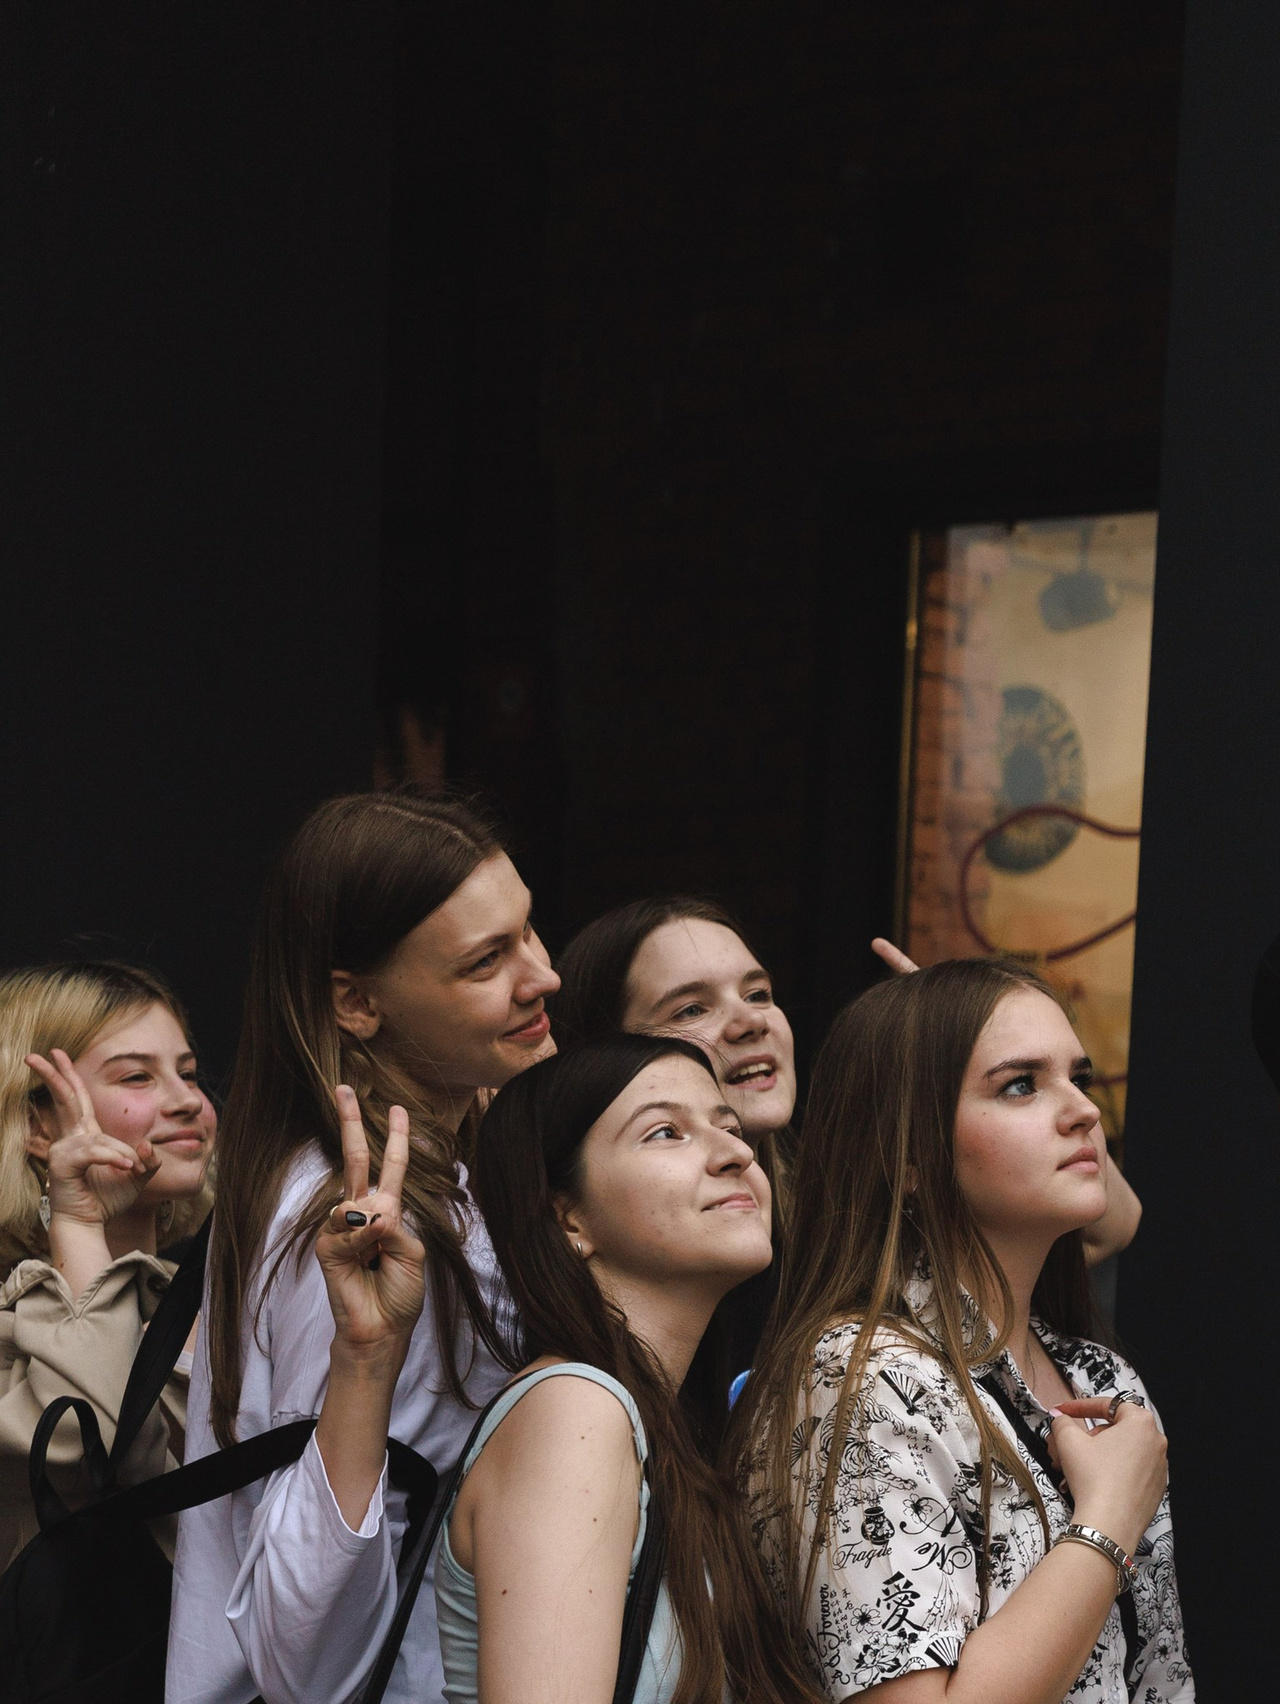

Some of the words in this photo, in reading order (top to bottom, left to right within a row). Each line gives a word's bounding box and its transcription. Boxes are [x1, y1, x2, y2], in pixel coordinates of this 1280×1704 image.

[832, 1540, 893, 1571] Fragile
[912, 1542, 973, 1576] Me
[816, 1583, 841, 1658] Forever
[1166, 1661, 1192, 1687] Frag
